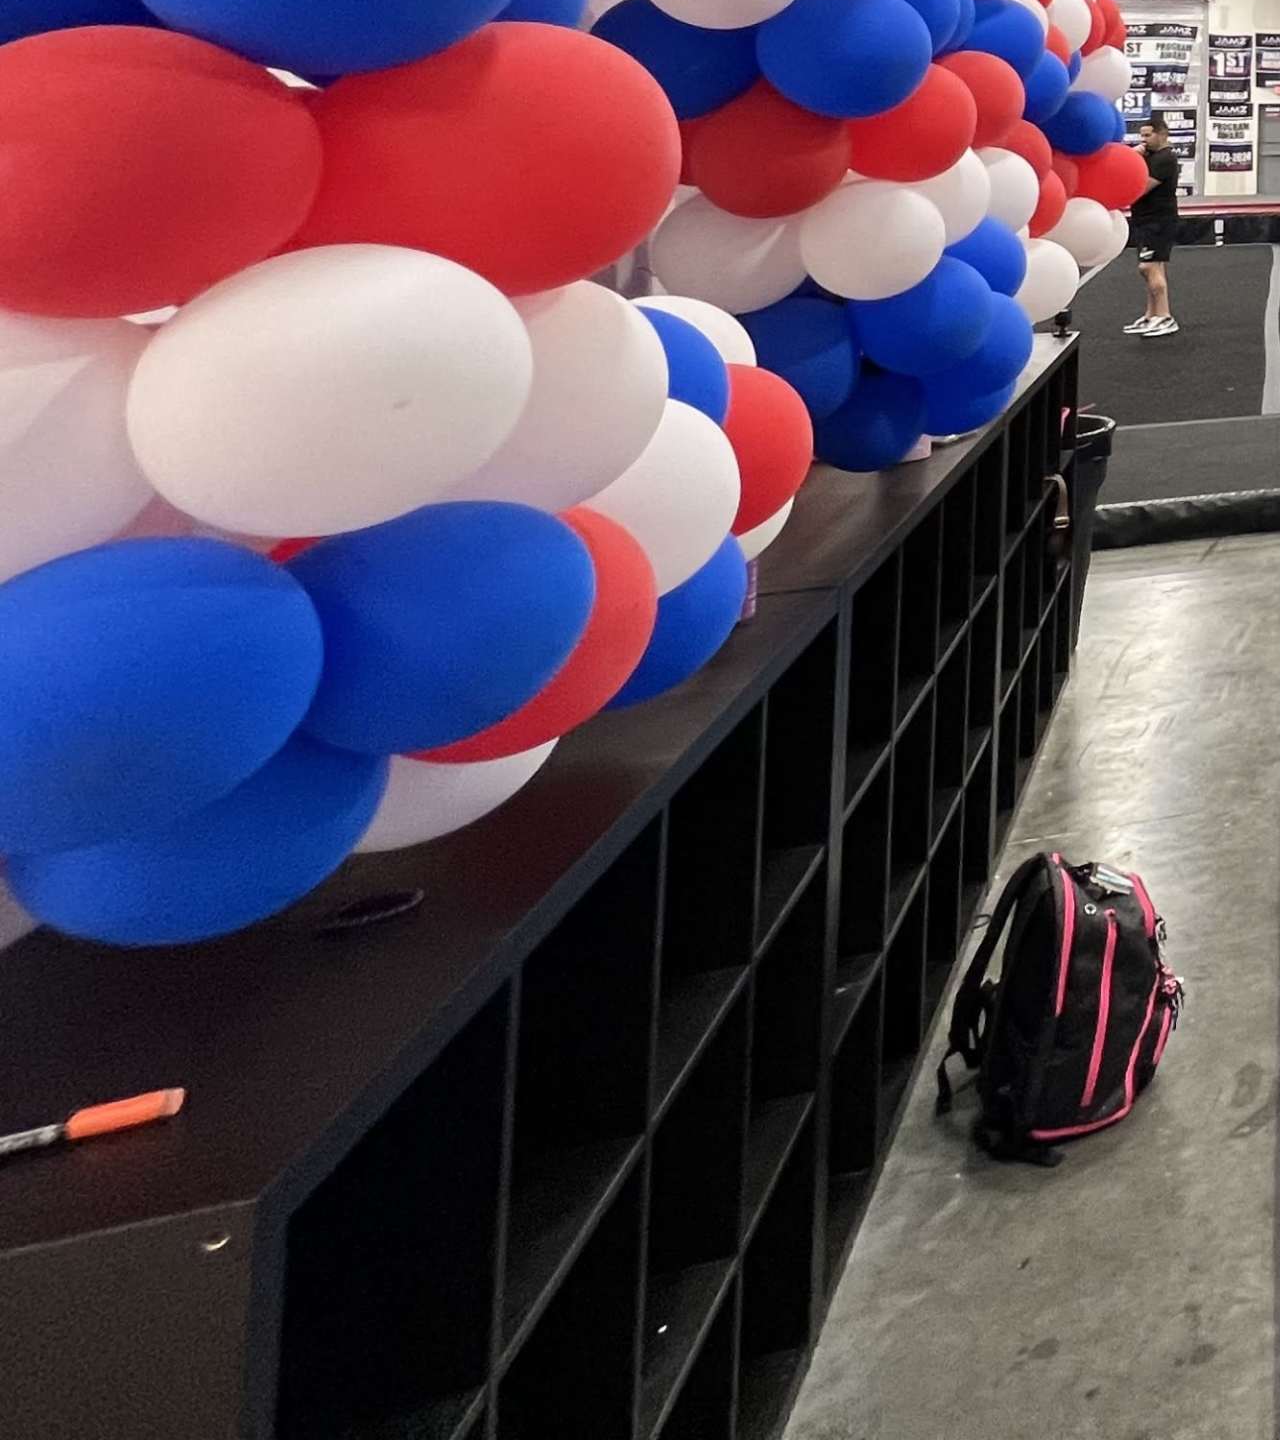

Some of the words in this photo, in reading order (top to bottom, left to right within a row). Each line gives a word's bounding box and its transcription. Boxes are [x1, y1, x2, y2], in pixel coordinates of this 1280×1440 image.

[1214, 36, 1248, 46] JAMZ
[1126, 42, 1143, 53] ST
[1213, 51, 1248, 77] 1ST
[1215, 105, 1248, 115] JAMZ
